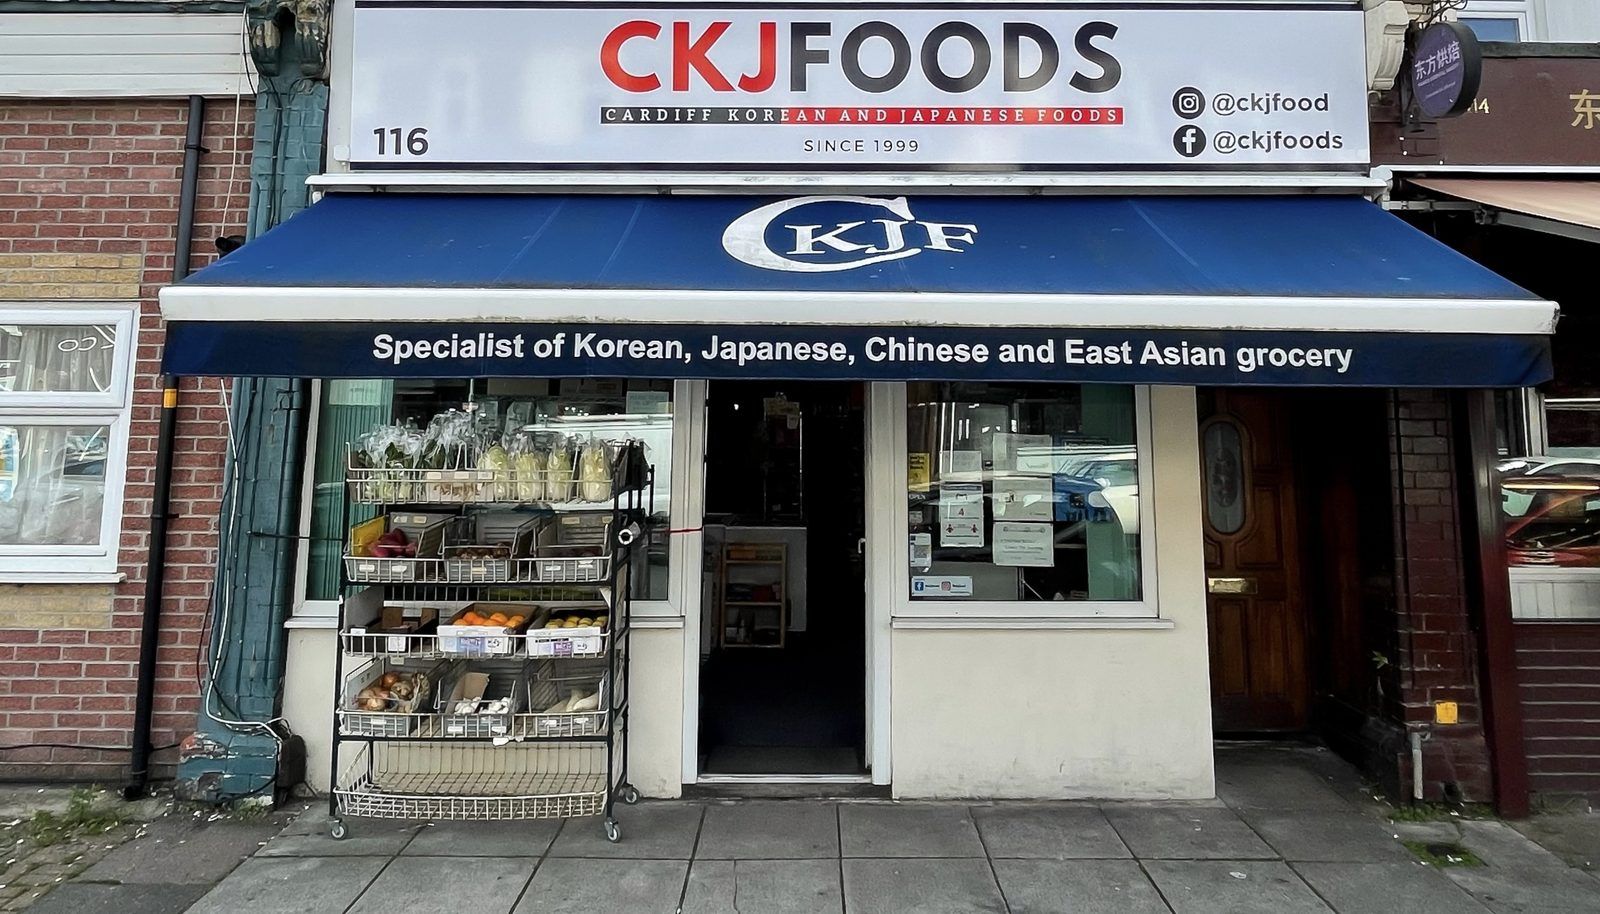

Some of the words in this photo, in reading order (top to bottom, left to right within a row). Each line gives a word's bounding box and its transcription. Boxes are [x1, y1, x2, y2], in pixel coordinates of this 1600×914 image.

[600, 20, 1122, 94] CKJFOODS
[1212, 92, 1329, 115] @ckjfood
[1467, 97, 1490, 114] 14
[605, 108, 712, 122] CARDIFF
[727, 108, 826, 122] KOREAN
[839, 109, 887, 122] AND
[900, 109, 1025, 123] JAPANESE
[1037, 109, 1116, 122] FOODS
[373, 127, 429, 156] 116
[804, 139, 864, 152] SINCE
[873, 139, 919, 152] 1999
[1212, 130, 1343, 154] @ckjfoods
[372, 332, 525, 365] Specialist
[533, 332, 566, 358] of
[573, 332, 692, 364] Korean,
[701, 335, 855, 367] Japanese,
[865, 336, 990, 363] Chinese
[998, 338, 1055, 364] and
[1065, 339, 1133, 365] East
[1139, 340, 1226, 366] Asian
[1236, 347, 1353, 373] grocery
